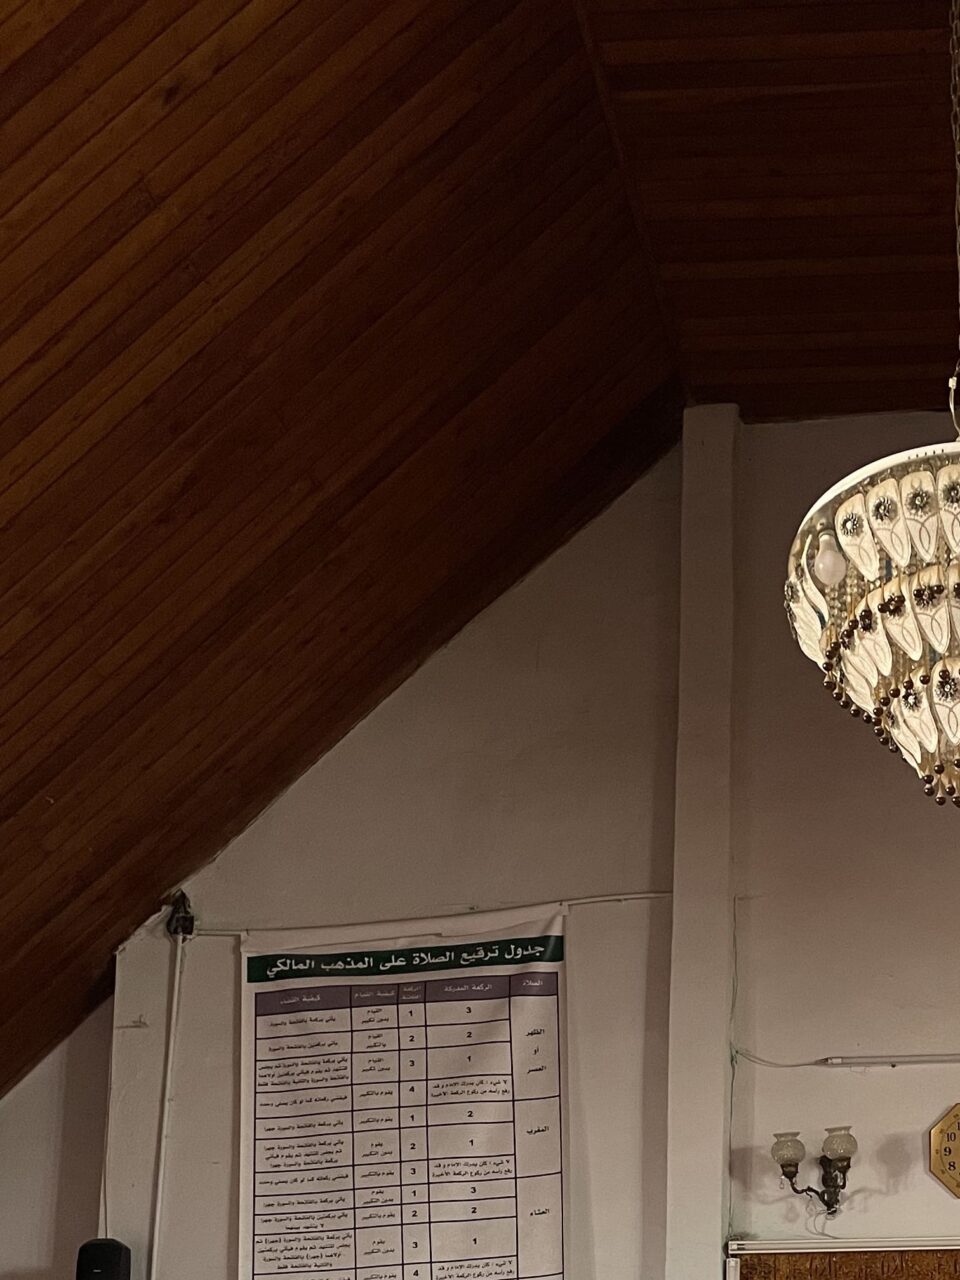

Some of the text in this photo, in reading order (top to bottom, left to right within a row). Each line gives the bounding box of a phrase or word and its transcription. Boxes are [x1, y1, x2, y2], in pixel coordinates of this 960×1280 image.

[266, 944, 545, 978] جدول ترقيع الصلاة على المذهب المالكي
[946, 1132, 957, 1142] 10
[943, 1146, 952, 1157] 9
[948, 1161, 957, 1172] 8
